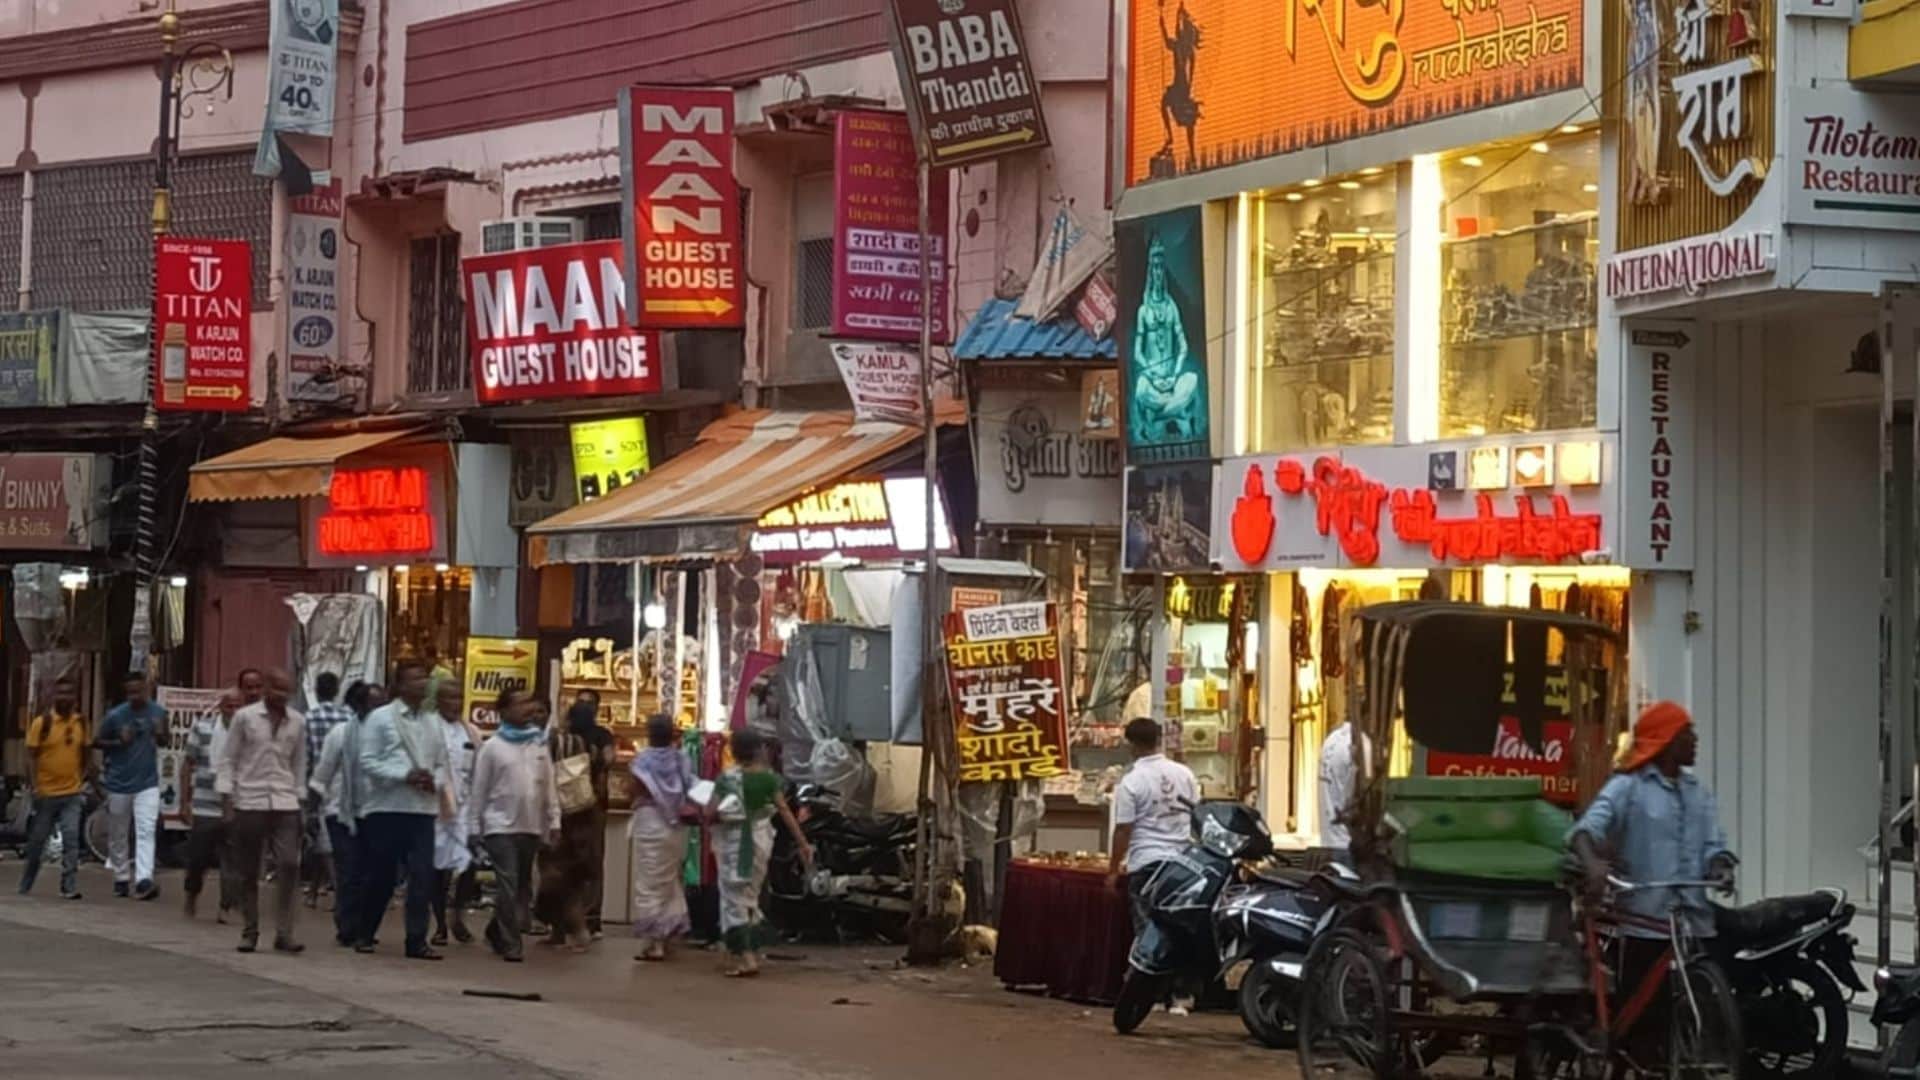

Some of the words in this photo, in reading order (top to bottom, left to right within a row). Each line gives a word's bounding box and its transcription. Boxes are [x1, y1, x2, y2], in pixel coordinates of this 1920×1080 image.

[906, 10, 1019, 74] BABA
[1411, 4, 1569, 88] rudraksha
[293, 55, 329, 72] TITAN
[309, 74, 323, 87] TO
[920, 61, 1030, 114] Thandai
[930, 121, 950, 140] की
[1804, 115, 1920, 159] Tilotam
[643, 104, 724, 234] MAAN
[645, 241, 732, 263] GUEST
[1607, 234, 1765, 297] INTERNATIONAL
[645, 267, 735, 289] HOUSE
[163, 293, 242, 319] TITAN
[471, 257, 627, 340] MAAN
[196, 325, 204, 341] K
[206, 326, 240, 341] ARJUN
[189, 346, 226, 361] WATCH
[482, 343, 556, 389] GUEST
[564, 335, 649, 382] HOUSE
[856, 353, 909, 369] KAMLA
[1650, 352, 1673, 562] RESTAURANT
[6, 480, 61, 509] BINNY
[474, 670, 527, 691] Nikon
[958, 722, 1044, 761] शादी
